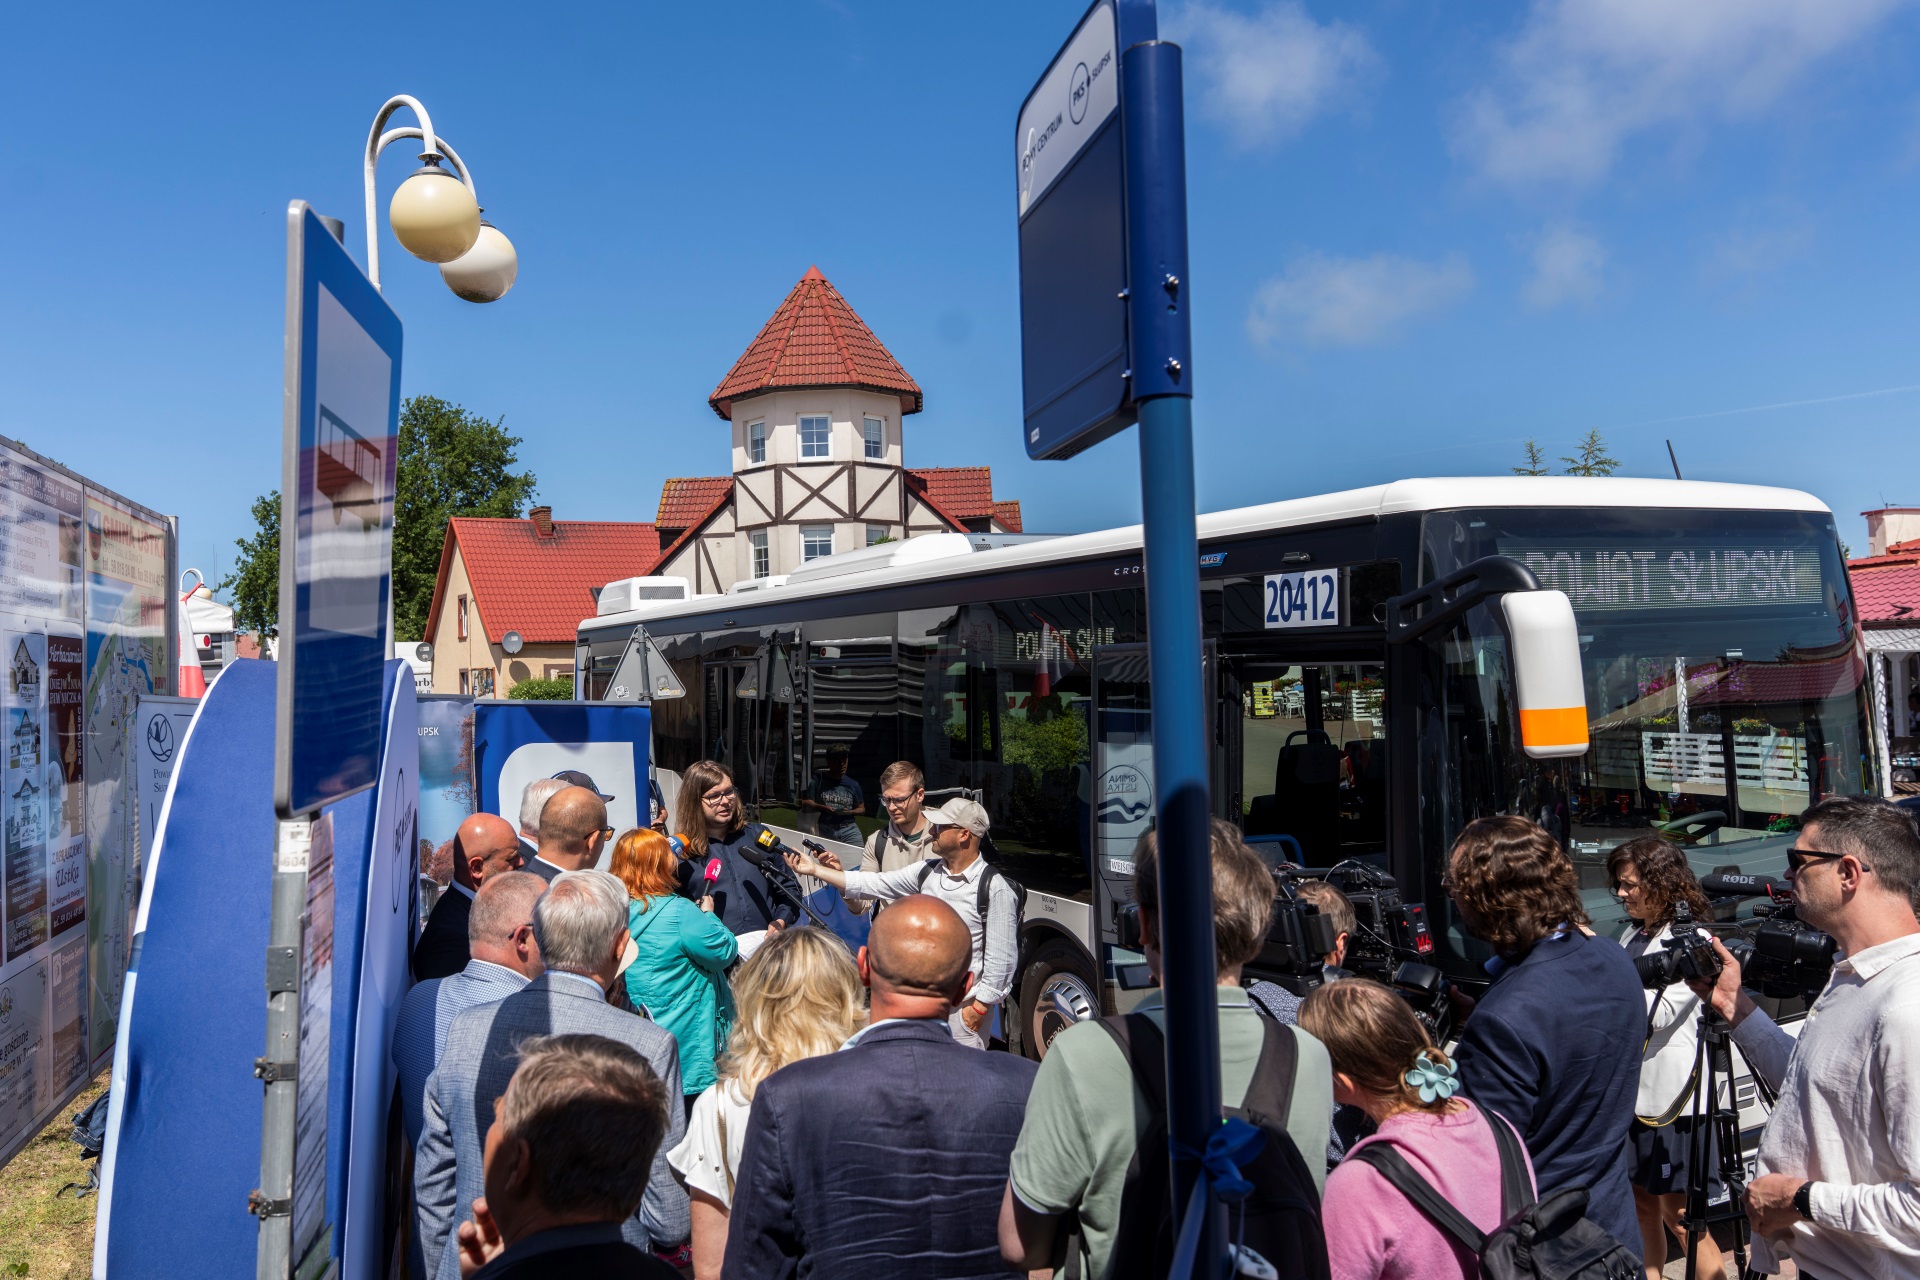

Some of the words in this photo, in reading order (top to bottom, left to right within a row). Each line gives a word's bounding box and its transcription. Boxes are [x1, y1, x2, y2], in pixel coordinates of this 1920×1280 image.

[1072, 82, 1085, 106] PKS
[1036, 112, 1063, 153] CENTRUM
[103, 514, 135, 548] GMINA
[138, 529, 166, 559] USTKA
[1668, 550, 1797, 600] SŁUPSKI
[1266, 575, 1335, 623] 20412
[55, 862, 79, 888] Ustka
[1722, 874, 1755, 885] RØDE
